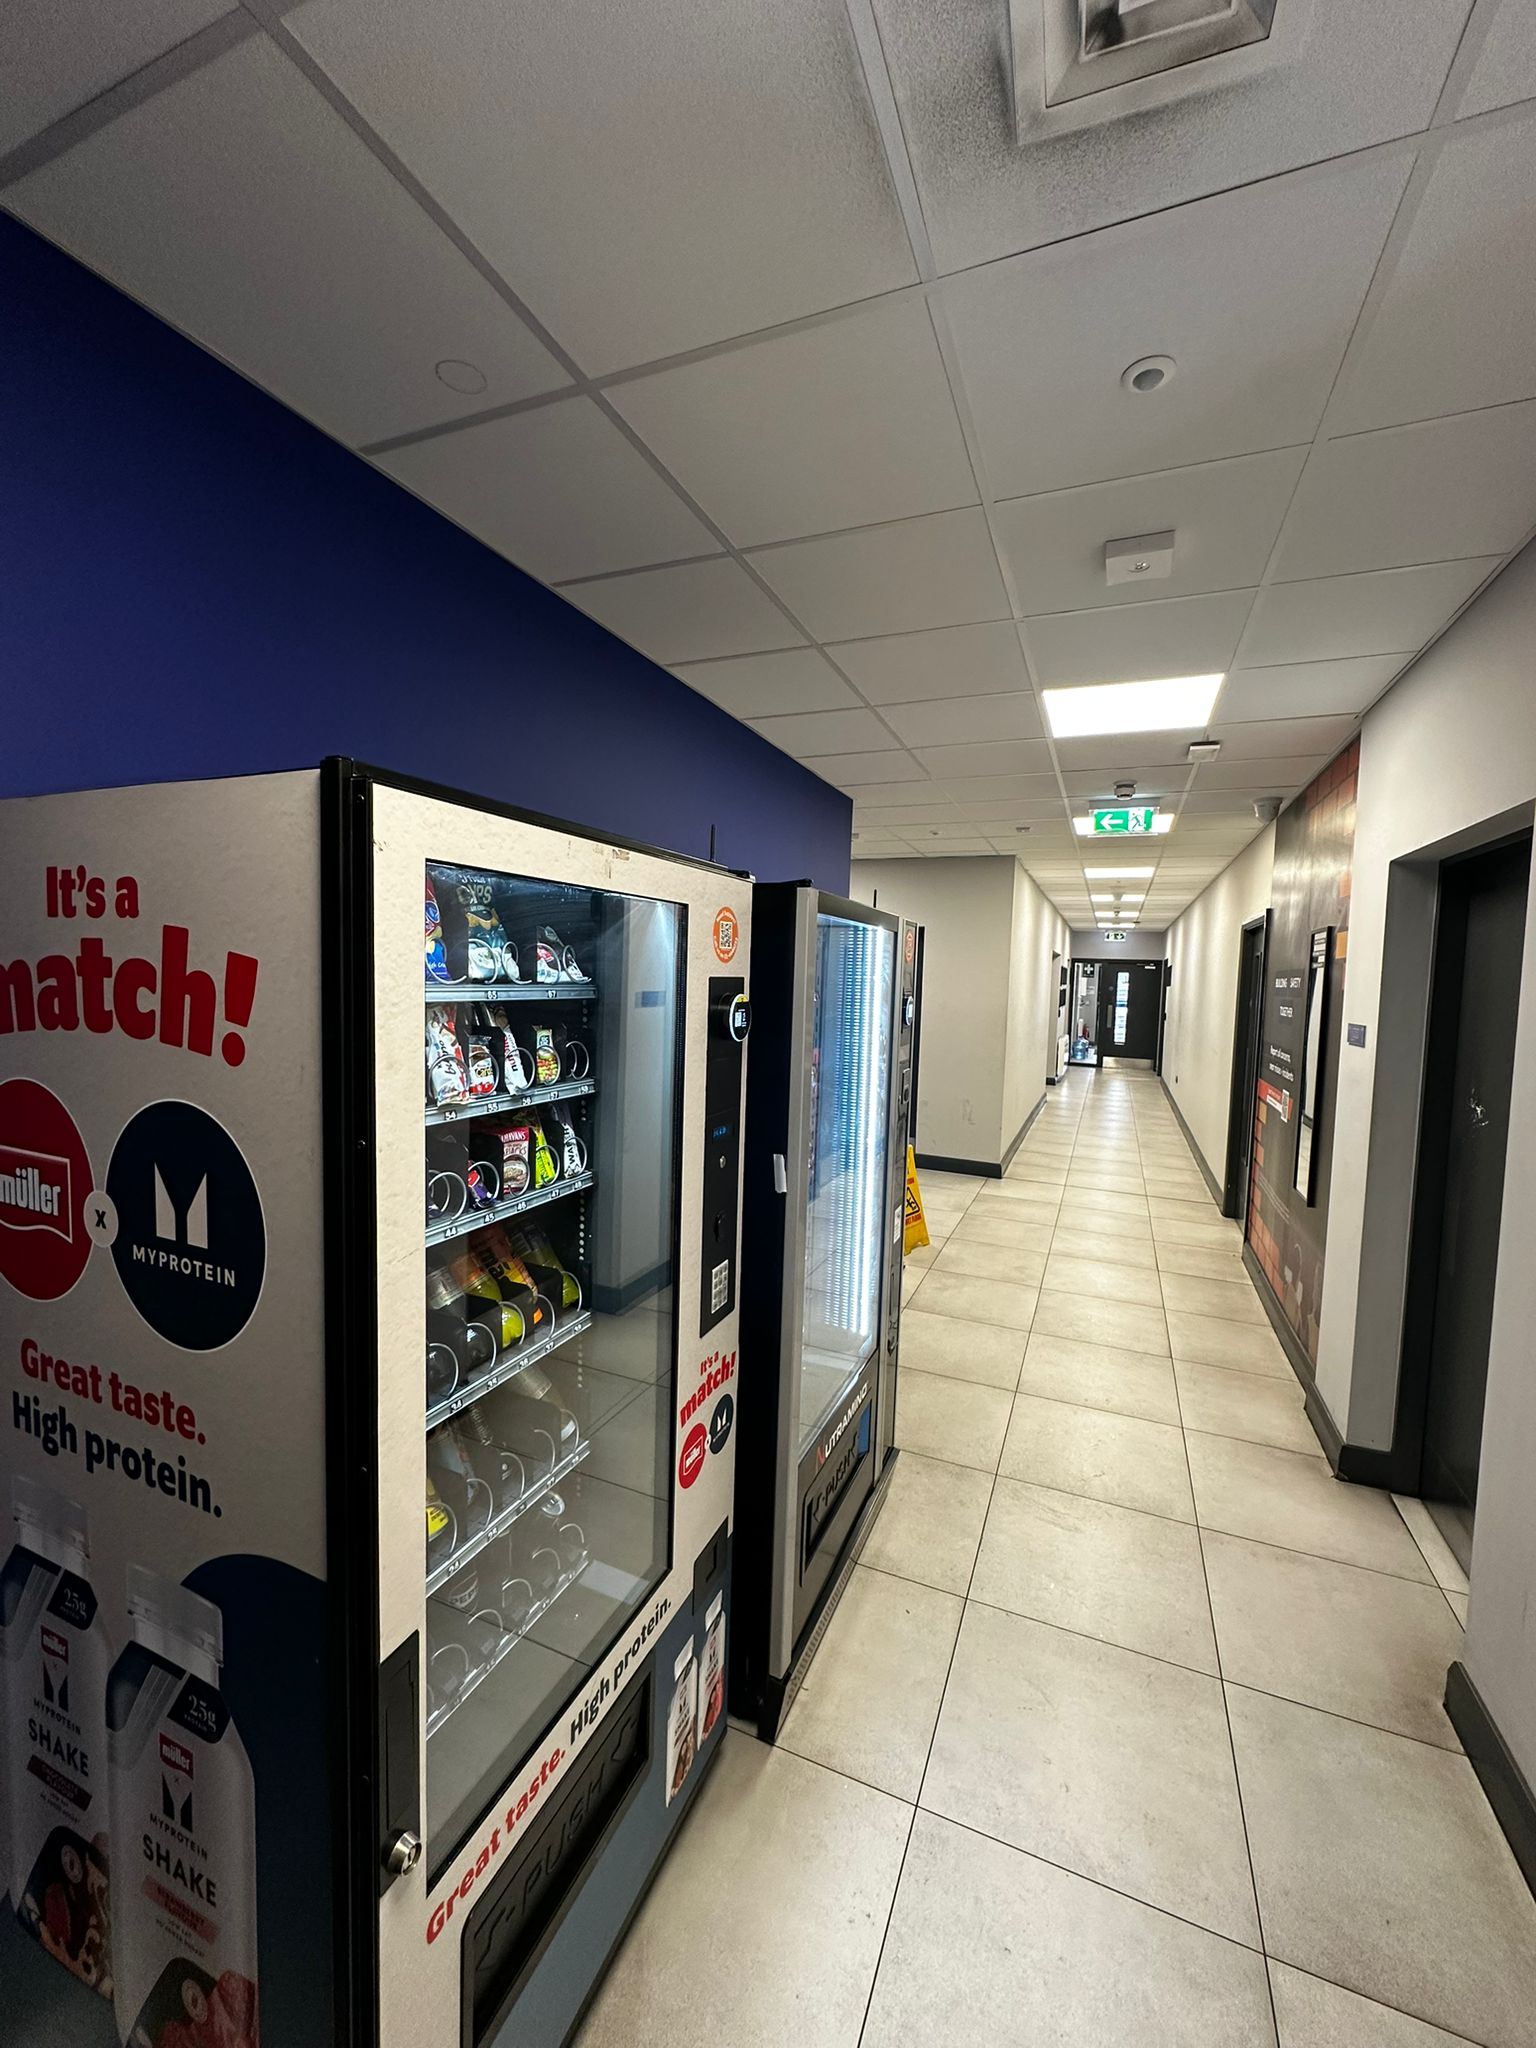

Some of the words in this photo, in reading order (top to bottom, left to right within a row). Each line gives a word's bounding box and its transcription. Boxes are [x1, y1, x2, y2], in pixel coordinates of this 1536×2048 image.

[46, 865, 106, 919] It's
[115, 876, 140, 919] a
[444, 1112, 456, 1120] 54
[487, 1104, 498, 1113] 55
[0, 1166, 61, 1217] müller
[445, 1229, 457, 1238] 44
[484, 1214, 495, 1223] 45
[132, 1244, 236, 1287] MYPROTEIN
[680, 1351, 736, 1428] match!
[700, 1355, 713, 1376] It's
[20, 1339, 102, 1403] Great
[109, 1376, 207, 1445] taste.
[815, 1381, 869, 1474] NUTRAMINO
[13, 1391, 78, 1456] High
[86, 1423, 223, 1518] protein.
[571, 1677, 610, 1745] High
[614, 1598, 672, 1691] protein.
[33, 1698, 82, 1736] MYPROTEIN
[187, 1695, 217, 1733] 25g
[28, 1718, 89, 1778] SHAKE
[161, 1745, 192, 1772] müller
[149, 1812, 208, 1862] MYPROTEIN
[426, 1827, 501, 1945] Great
[505, 1747, 566, 1834] taste.
[142, 1834, 217, 1908] SHAKE
